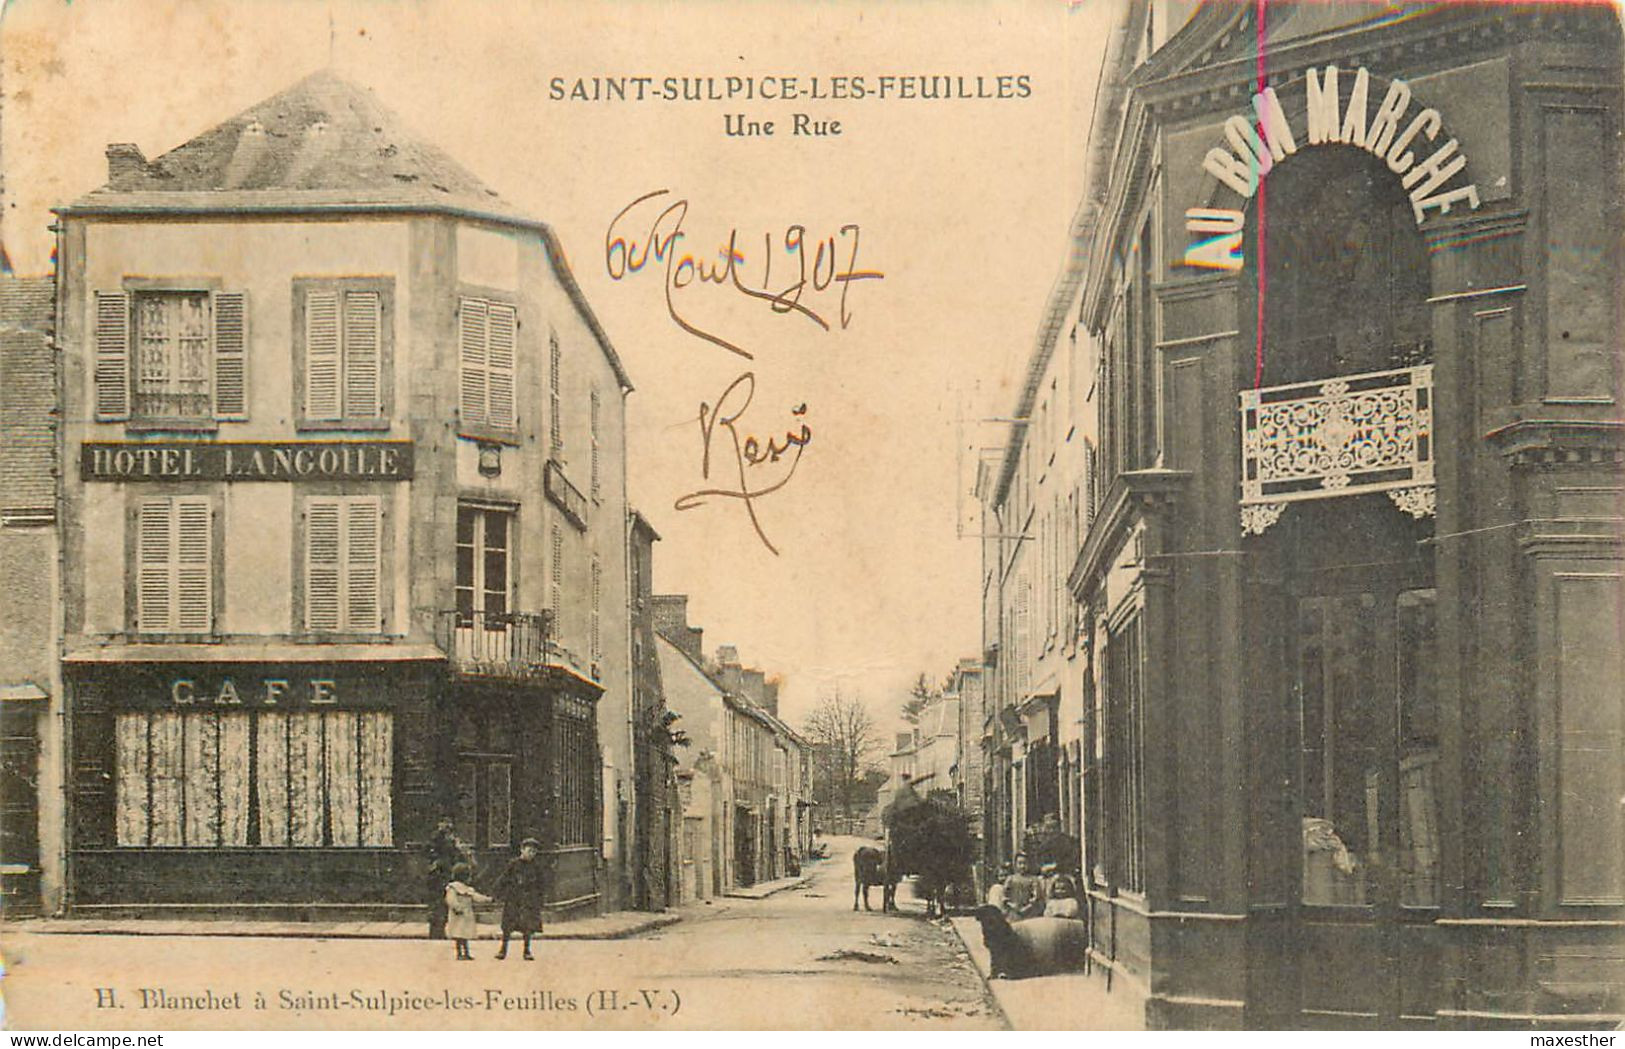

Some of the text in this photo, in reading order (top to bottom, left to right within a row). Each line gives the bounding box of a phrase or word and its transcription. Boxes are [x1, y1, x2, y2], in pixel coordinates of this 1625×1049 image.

[1184, 65, 1480, 270] AU BON MARCHE
[764, 225, 885, 330] 1907
[92, 449, 399, 475] HOTEL LANGOILE
[172, 679, 338, 704] CAFE
